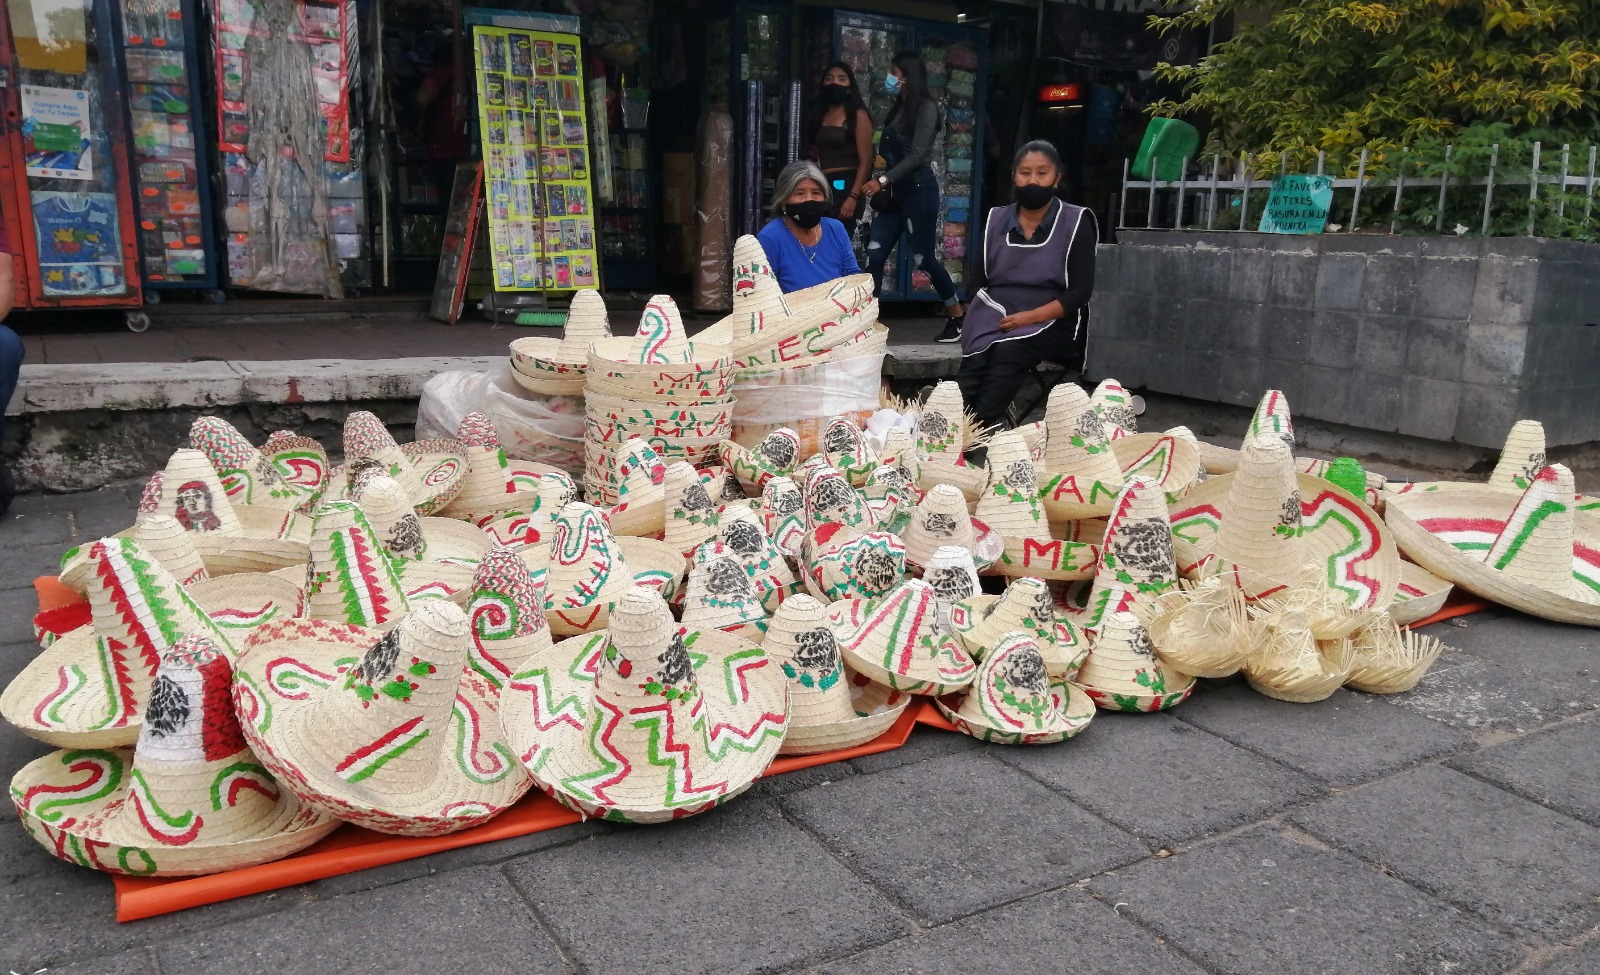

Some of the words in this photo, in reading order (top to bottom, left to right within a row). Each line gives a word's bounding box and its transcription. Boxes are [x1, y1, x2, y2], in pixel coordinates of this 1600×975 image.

[33, 102, 61, 110] Compra
[1271, 196, 1280, 206] NO
[1283, 196, 1313, 206] TIRES
[1267, 209, 1300, 219] BASURA
[1303, 209, 1314, 219] EN
